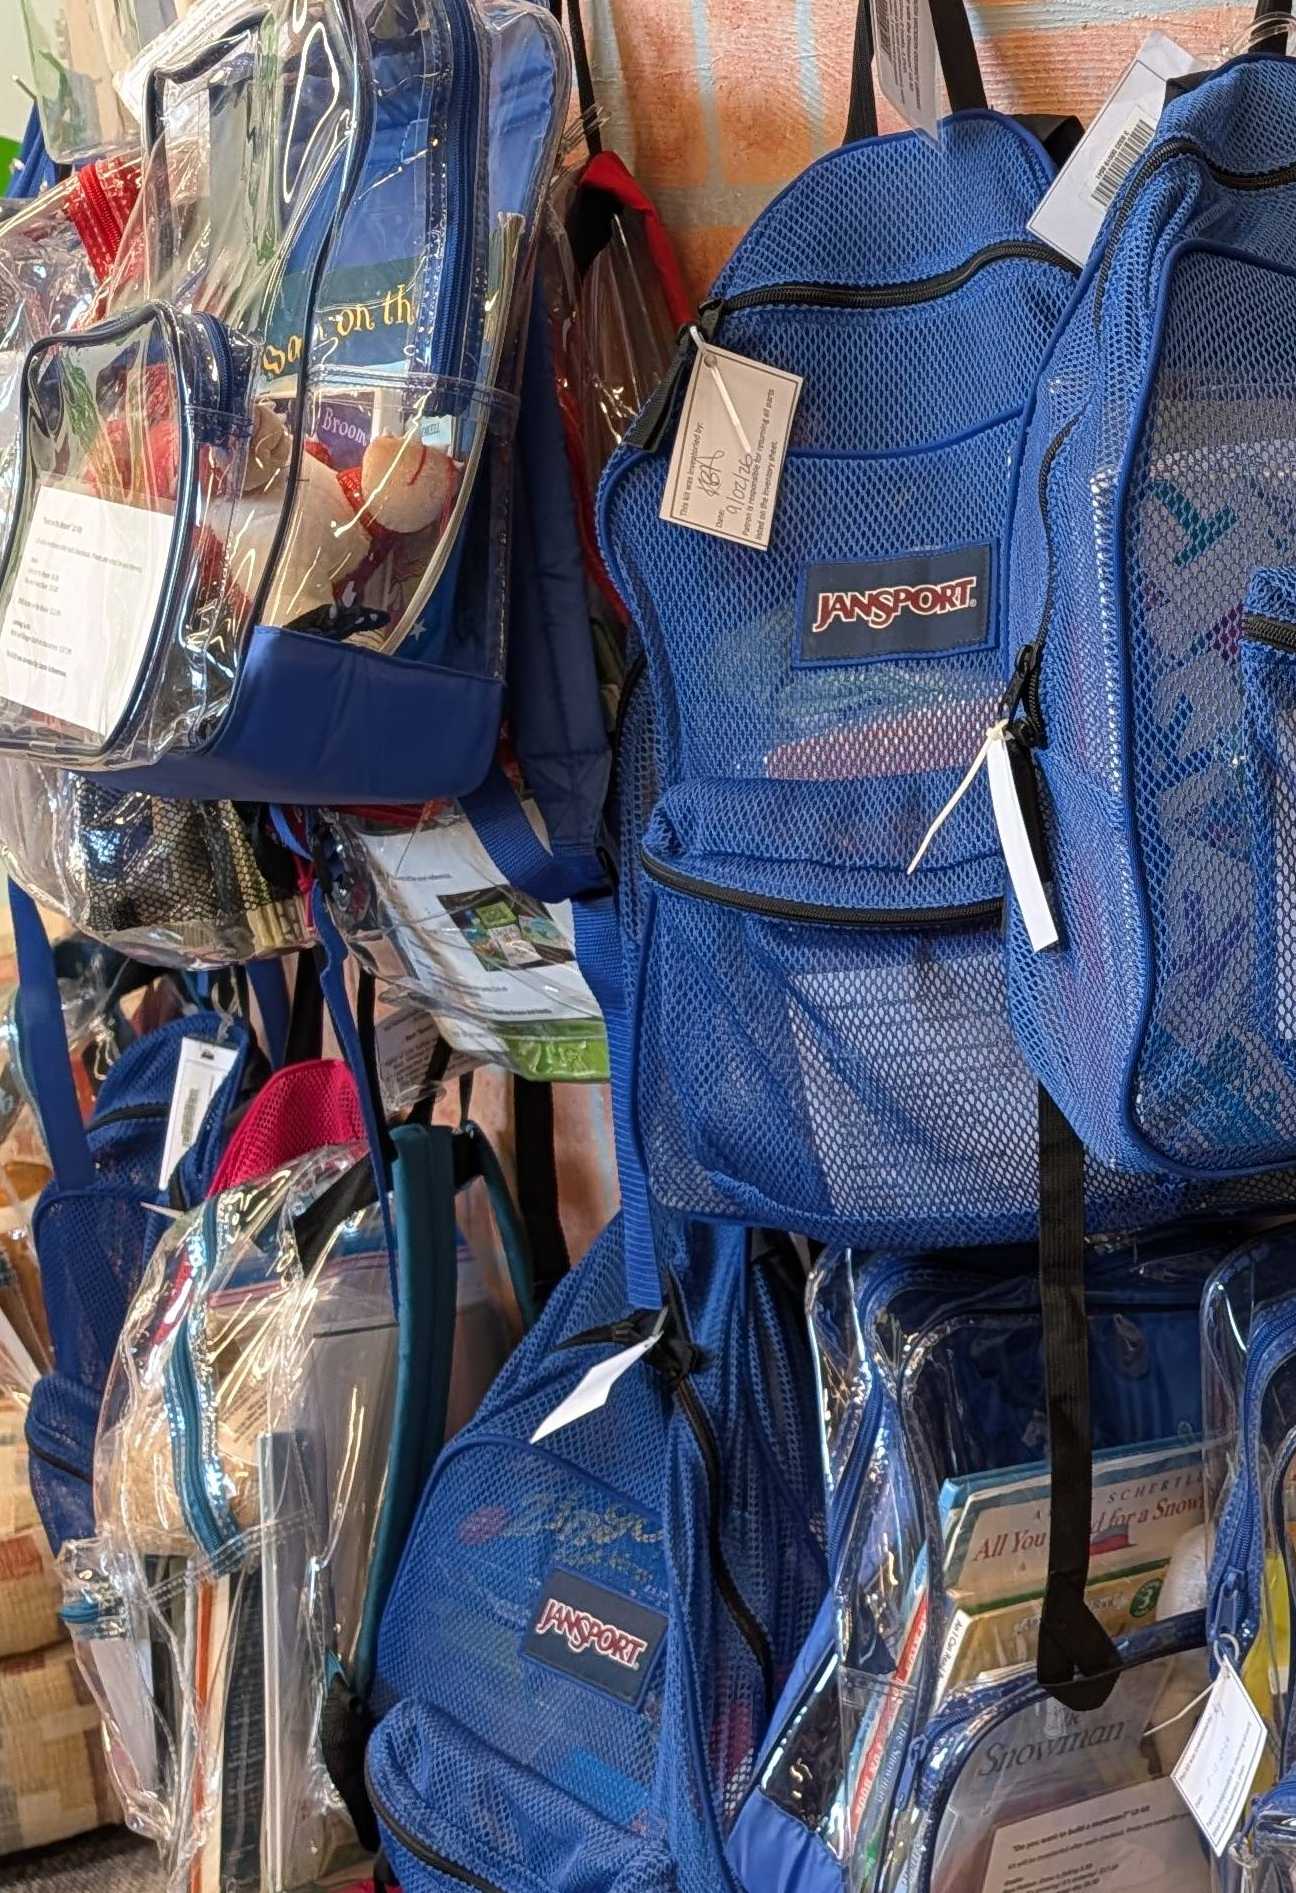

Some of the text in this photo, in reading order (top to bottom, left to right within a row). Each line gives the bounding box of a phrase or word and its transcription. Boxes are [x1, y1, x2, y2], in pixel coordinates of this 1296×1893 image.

[336, 304, 376, 336] on
[383, 284, 416, 325] th
[321, 407, 369, 446] Broom
[812, 577, 974, 632] JANSPORT
[974, 1534, 1009, 1562] All
[1012, 1529, 1047, 1554] You
[1106, 1507, 1136, 1528] for
[1138, 1510, 1149, 1524] a
[1153, 1495, 1206, 1521] Snow
[535, 1598, 648, 1668] JANSPORT
[979, 1720, 1125, 1777] Snowman
